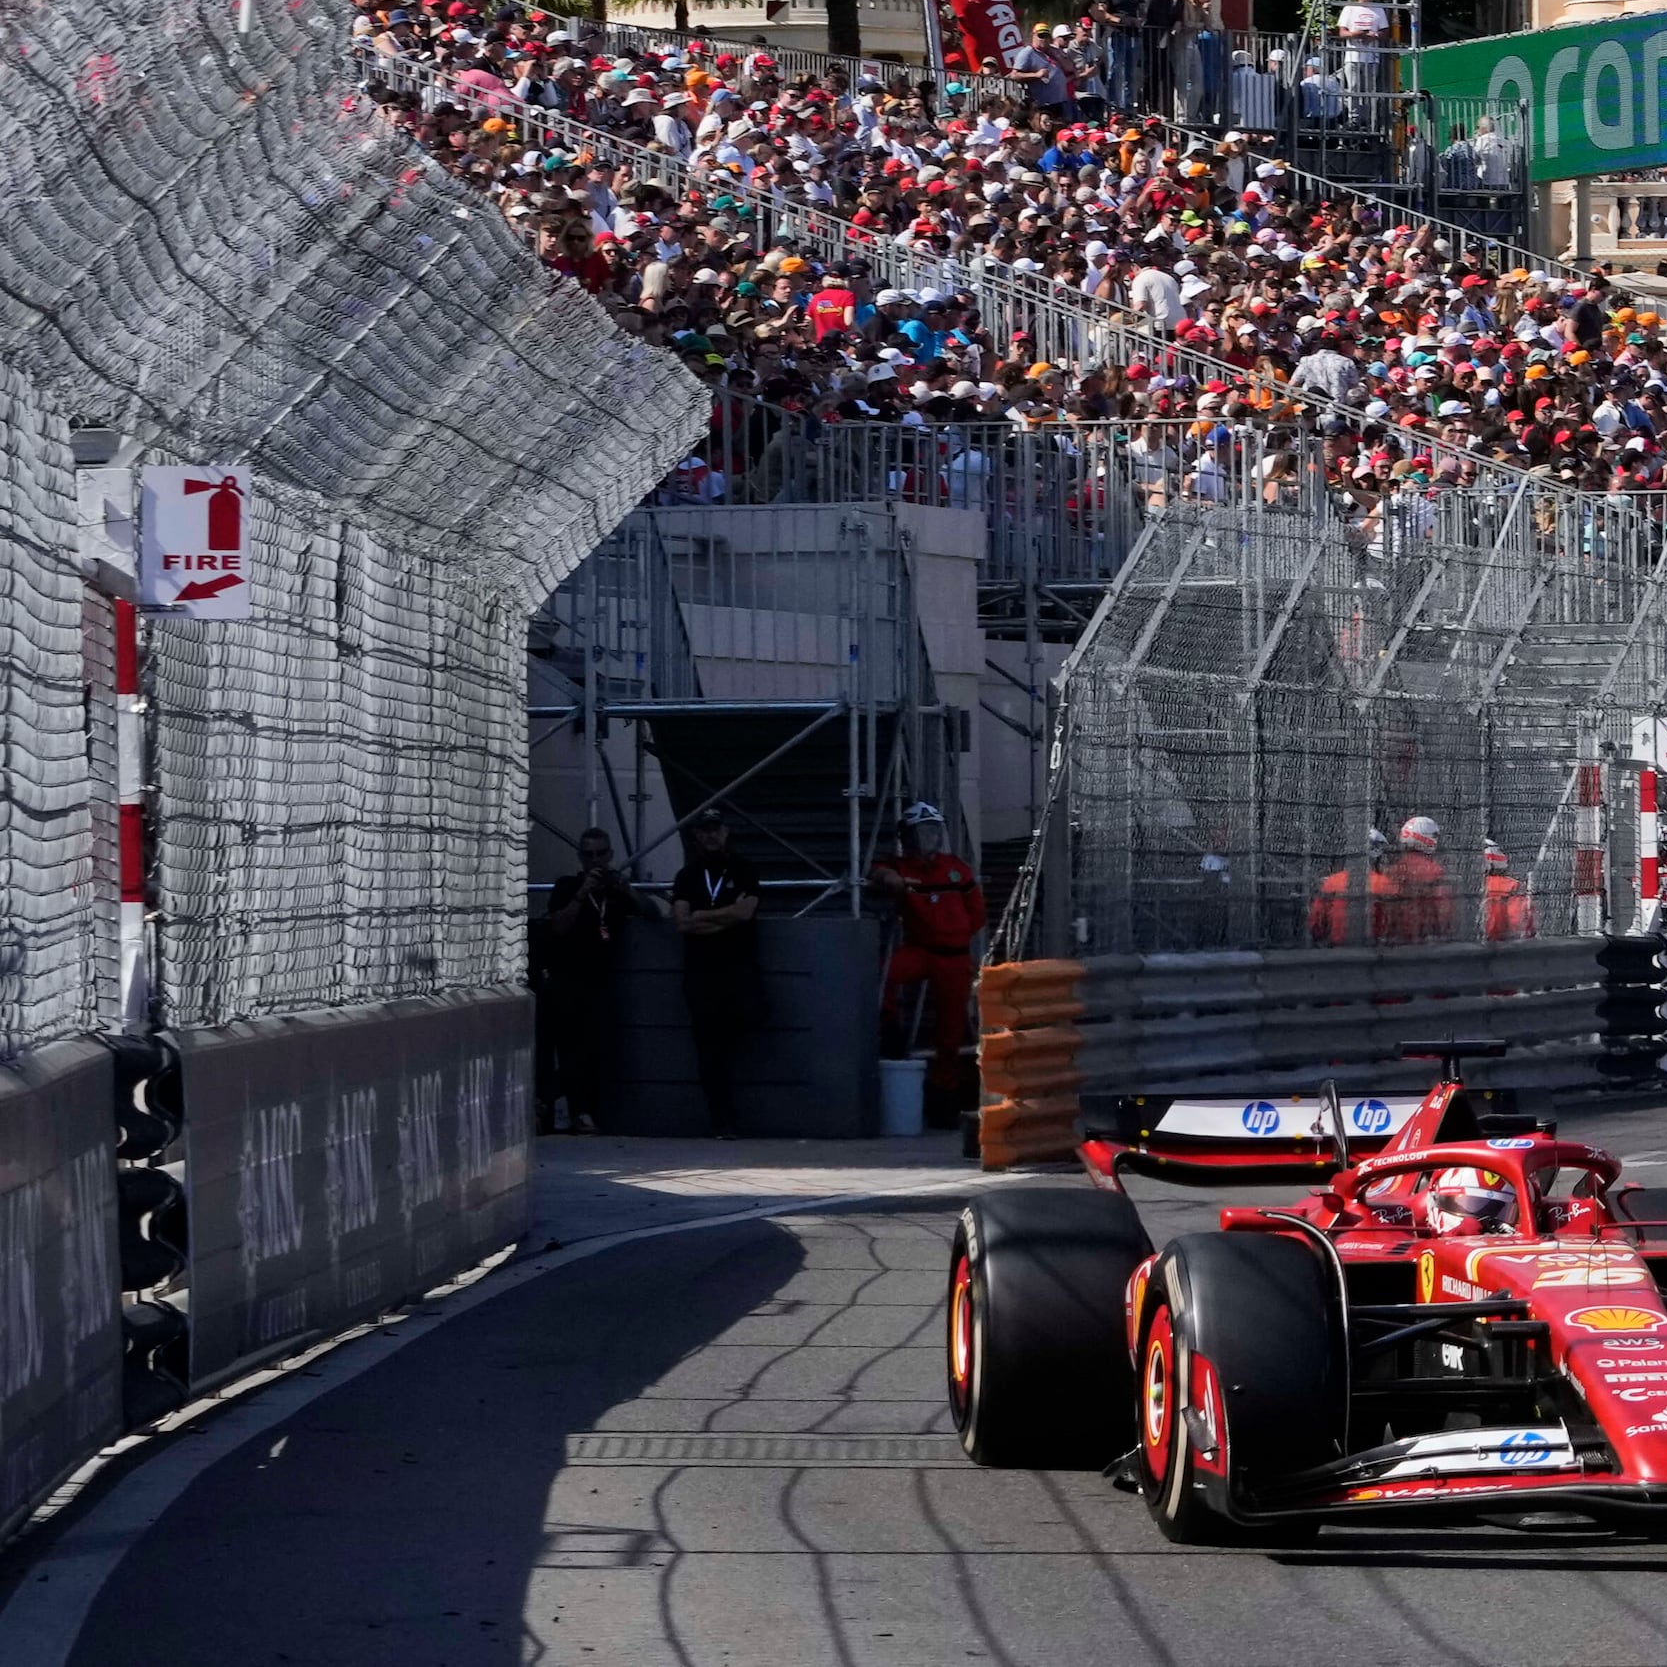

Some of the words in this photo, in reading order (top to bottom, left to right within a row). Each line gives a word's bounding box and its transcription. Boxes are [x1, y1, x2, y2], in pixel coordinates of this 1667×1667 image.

[163, 555, 241, 570] FIRE
[1243, 1101, 1279, 1135] hp
[1354, 1099, 1391, 1133] hp
[343, 1087, 378, 1231] MSC
[1374, 1151, 1429, 1165] TECHNOLOGY
[260, 1102, 303, 1258] MSC
[1549, 1202, 1591, 1222] Ray-Ban
[1496, 1253, 1634, 1263] VGW
[1442, 1275, 1471, 1300] RICHARD
[1532, 1267, 1648, 1290] 16
[1603, 1338, 1660, 1346] aws
[1500, 1432, 1551, 1465] hp
[1384, 1484, 1512, 1499] V-Power
